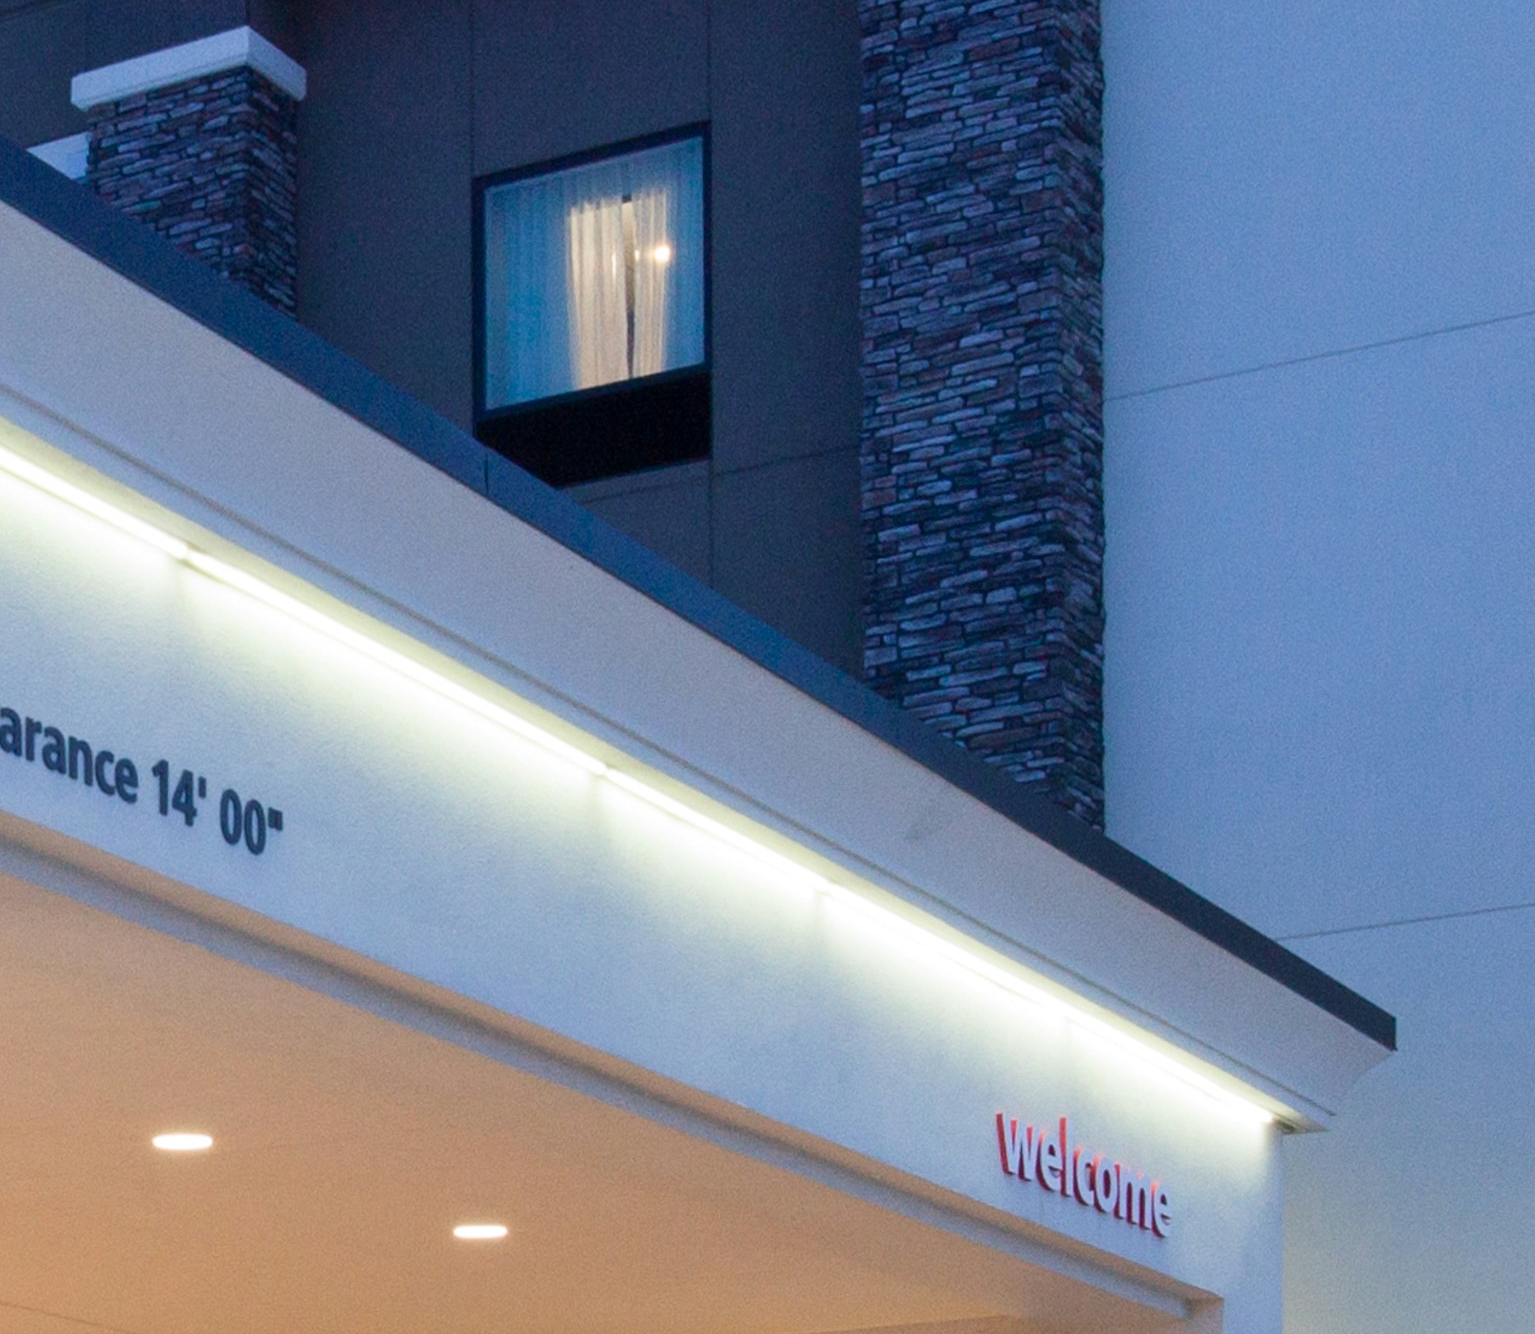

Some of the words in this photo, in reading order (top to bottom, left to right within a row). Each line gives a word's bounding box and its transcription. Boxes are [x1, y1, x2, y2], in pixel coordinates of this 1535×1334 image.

[151, 759, 207, 827] 14'
[220, 788, 284, 856] 00"
[995, 1112, 1173, 1239] welcome
